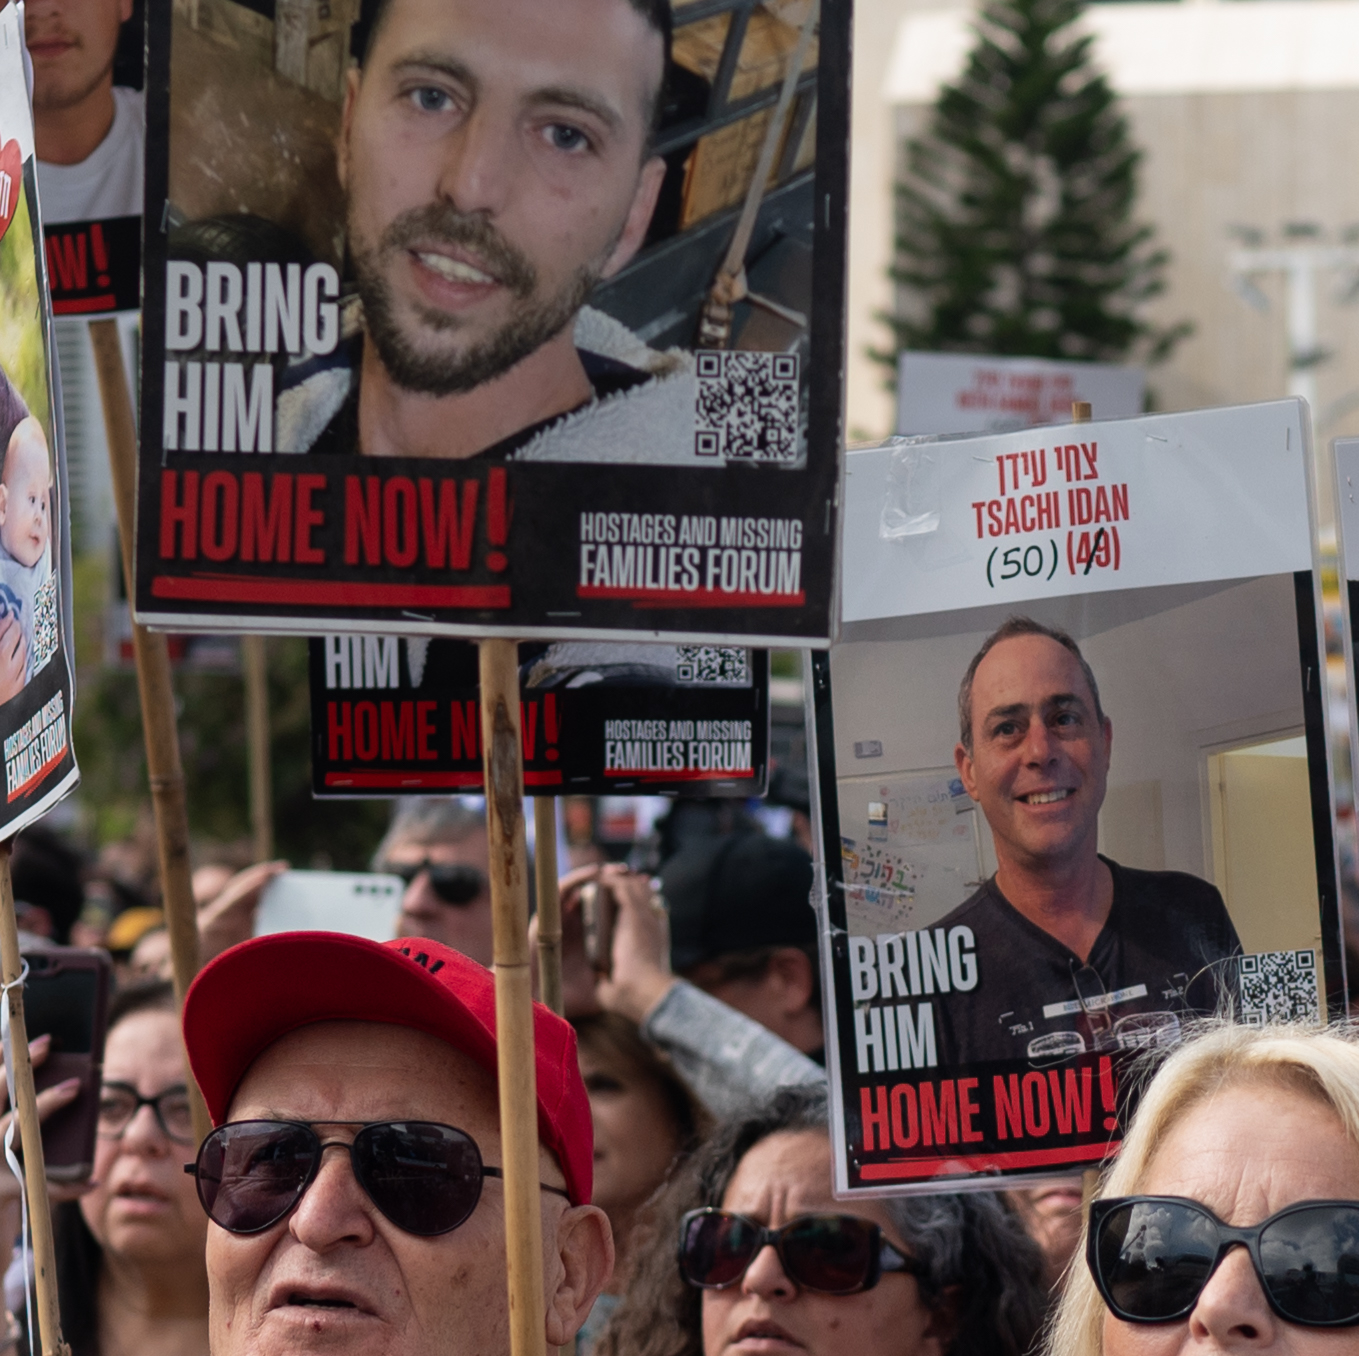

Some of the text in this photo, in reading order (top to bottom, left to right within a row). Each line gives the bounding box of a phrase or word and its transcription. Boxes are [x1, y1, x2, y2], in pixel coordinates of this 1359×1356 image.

[165, 260, 341, 355] BRING
[162, 362, 277, 454] HIM
[996, 442, 1100, 496] צחי עידן
[160, 467, 514, 571] HOME NOW!
[580, 512, 803, 551] HOSTAGES AND MISSING
[972, 484, 1130, 540] TSACHI IDAN
[580, 545, 802, 597] FAMILIES FORUM
[986, 538, 1059, 588] (50)
[325, 635, 400, 689] HIM
[328, 701, 438, 761] HOME
[605, 720, 752, 741] HOSTAGES AND MISSING
[605, 741, 752, 771] FAMILIES FORUM
[848, 925, 978, 1001] BRING
[855, 1003, 937, 1073] HIM
[860, 1055, 1118, 1151] HOME NOW!
